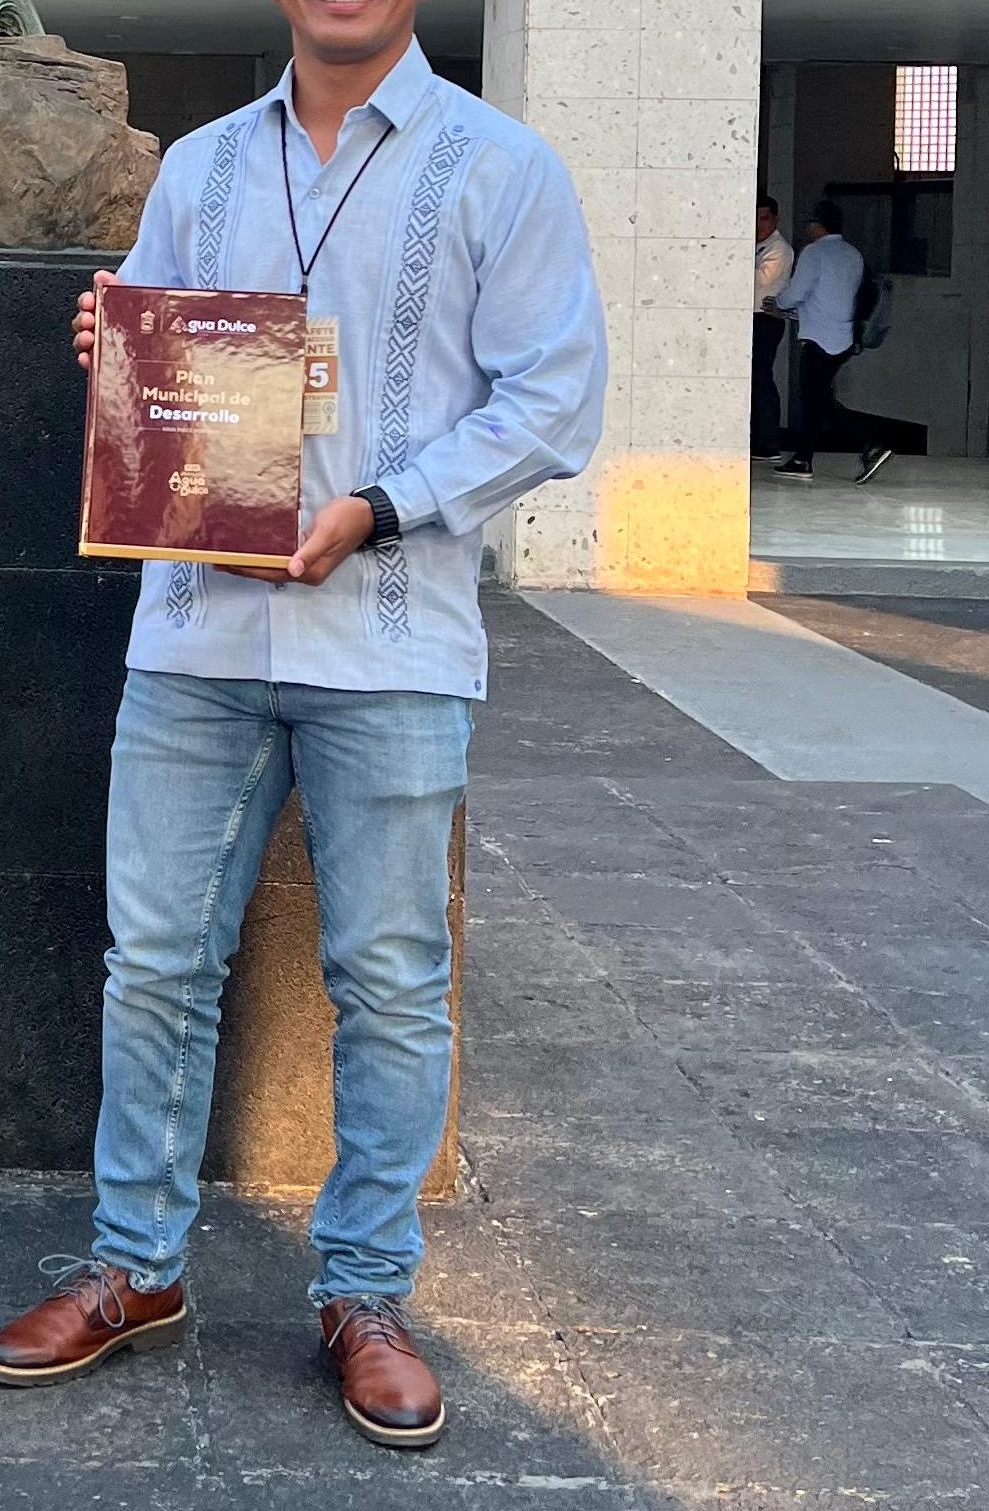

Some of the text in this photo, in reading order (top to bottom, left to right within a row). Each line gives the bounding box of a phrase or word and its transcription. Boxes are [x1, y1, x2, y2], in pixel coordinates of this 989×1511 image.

[217, 318, 257, 333] Dulce
[175, 370, 215, 385] Plan
[142, 387, 251, 407] Municipal de
[149, 405, 240, 424] Desarrollo
